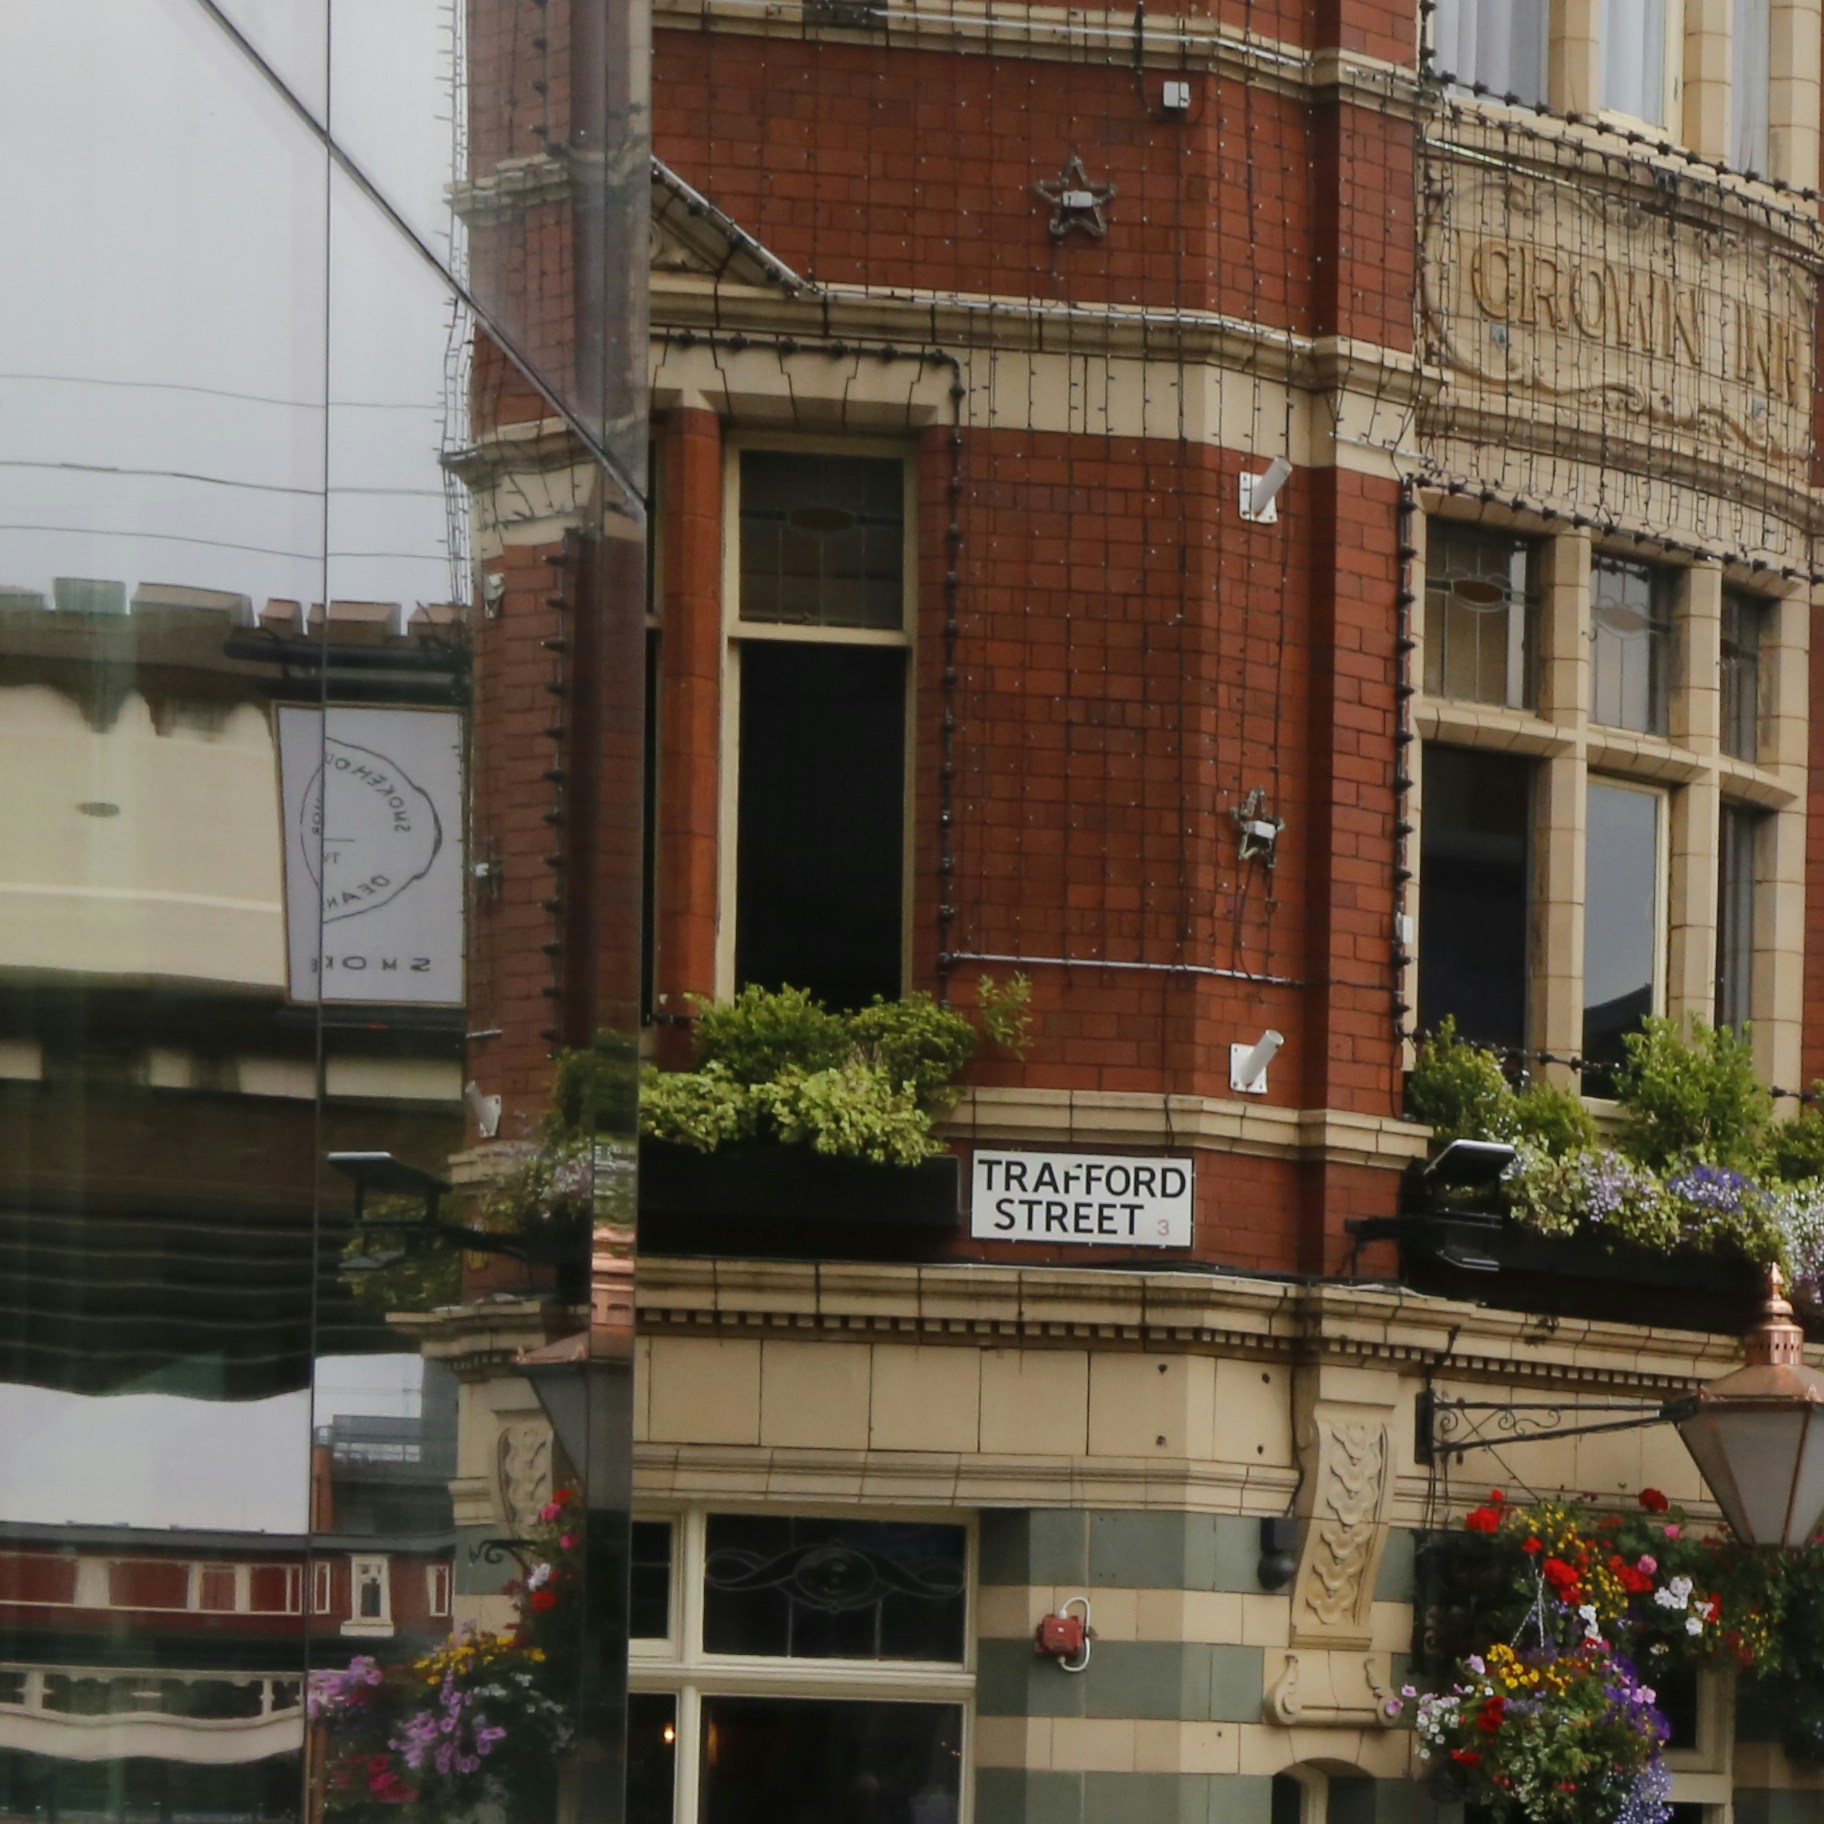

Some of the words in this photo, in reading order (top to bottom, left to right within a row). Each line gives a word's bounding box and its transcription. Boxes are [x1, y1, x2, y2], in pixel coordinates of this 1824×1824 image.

[1470, 238, 1702, 367] CROWN
[1734, 300, 1799, 406] INN
[978, 1159, 1187, 1199] TRAFFORD
[994, 1198, 1144, 1236] STREET
[1157, 1219, 1170, 1237] 3
